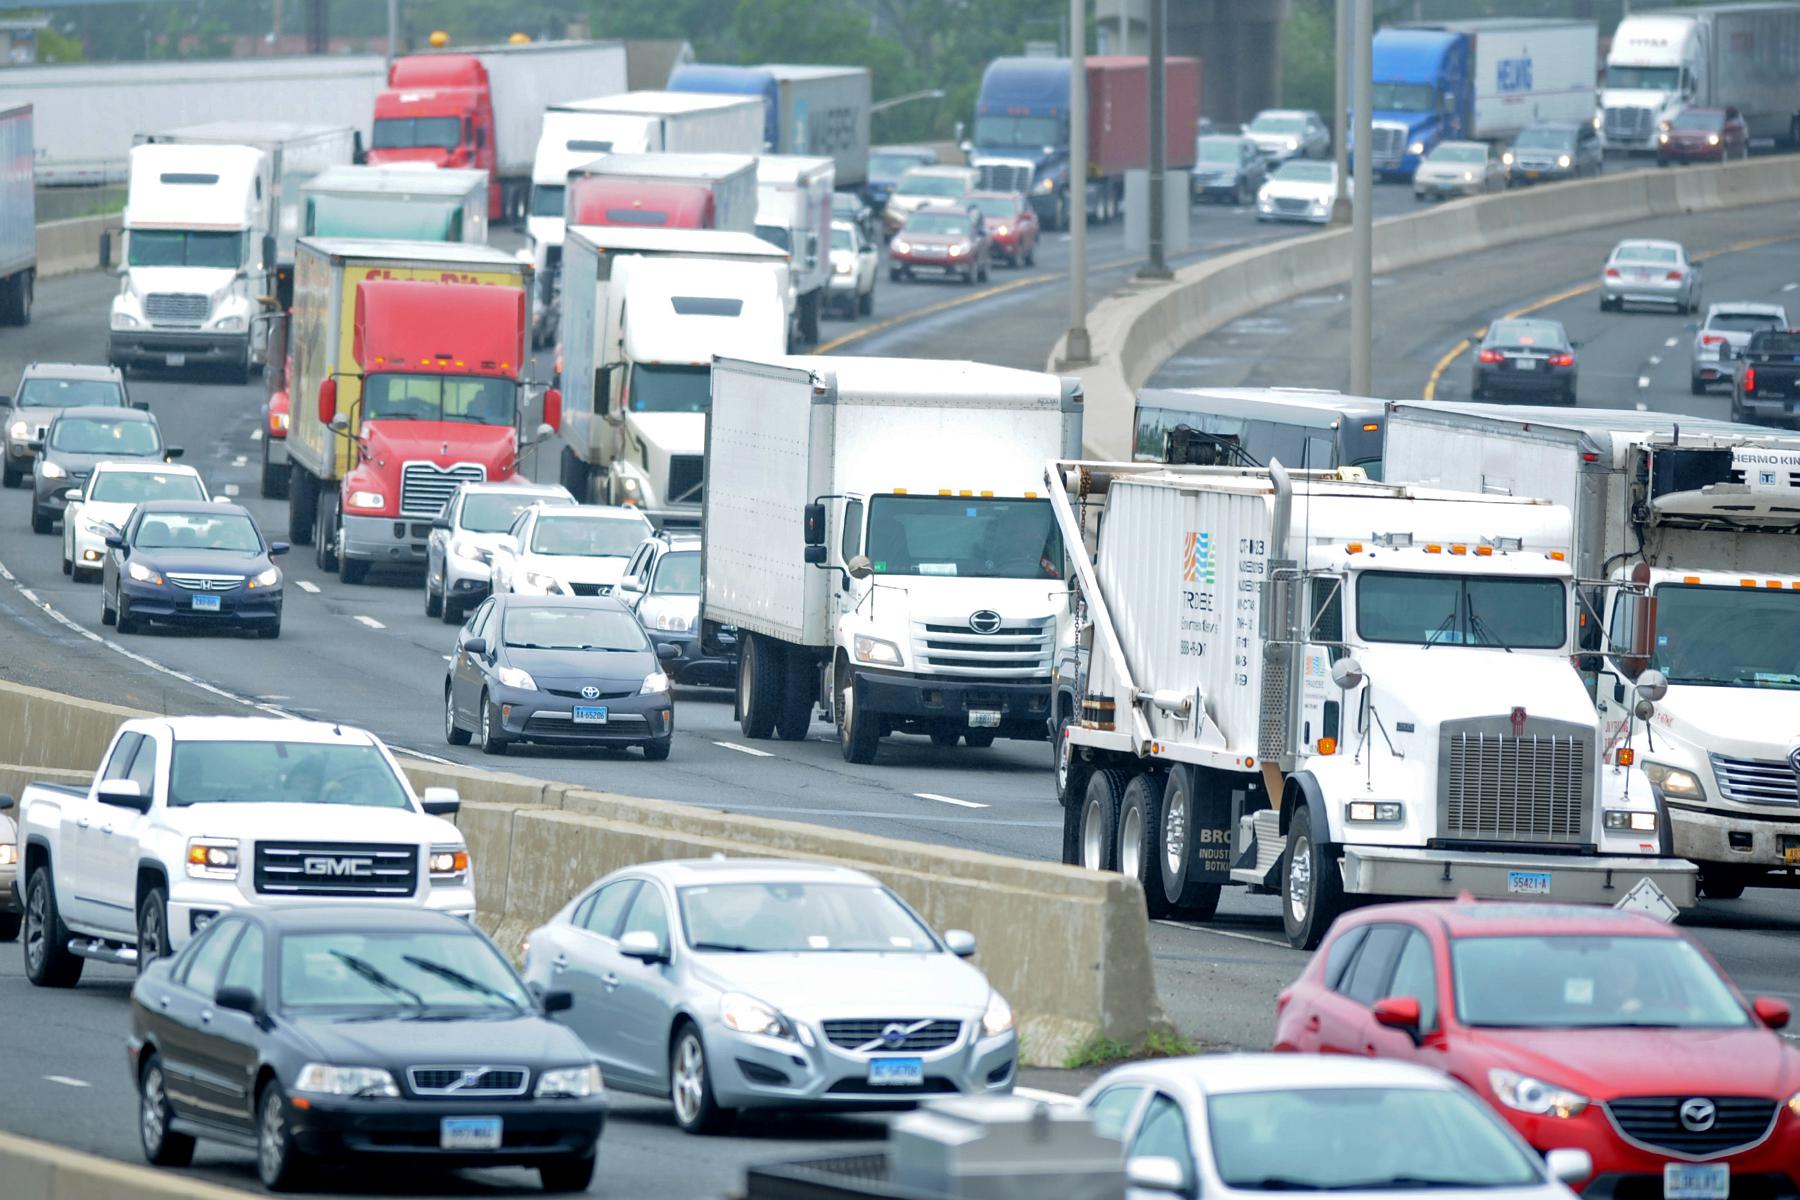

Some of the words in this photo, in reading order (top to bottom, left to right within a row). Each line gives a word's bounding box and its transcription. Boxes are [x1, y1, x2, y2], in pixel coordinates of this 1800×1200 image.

[1733, 454, 1779, 465] HERMO
[1780, 456, 1800, 465] KIN
[1200, 828, 1232, 844] BRO
[1199, 848, 1232, 859] INDUST
[304, 857, 373, 876] GMC
[1205, 860, 1231, 871] BOTKI
